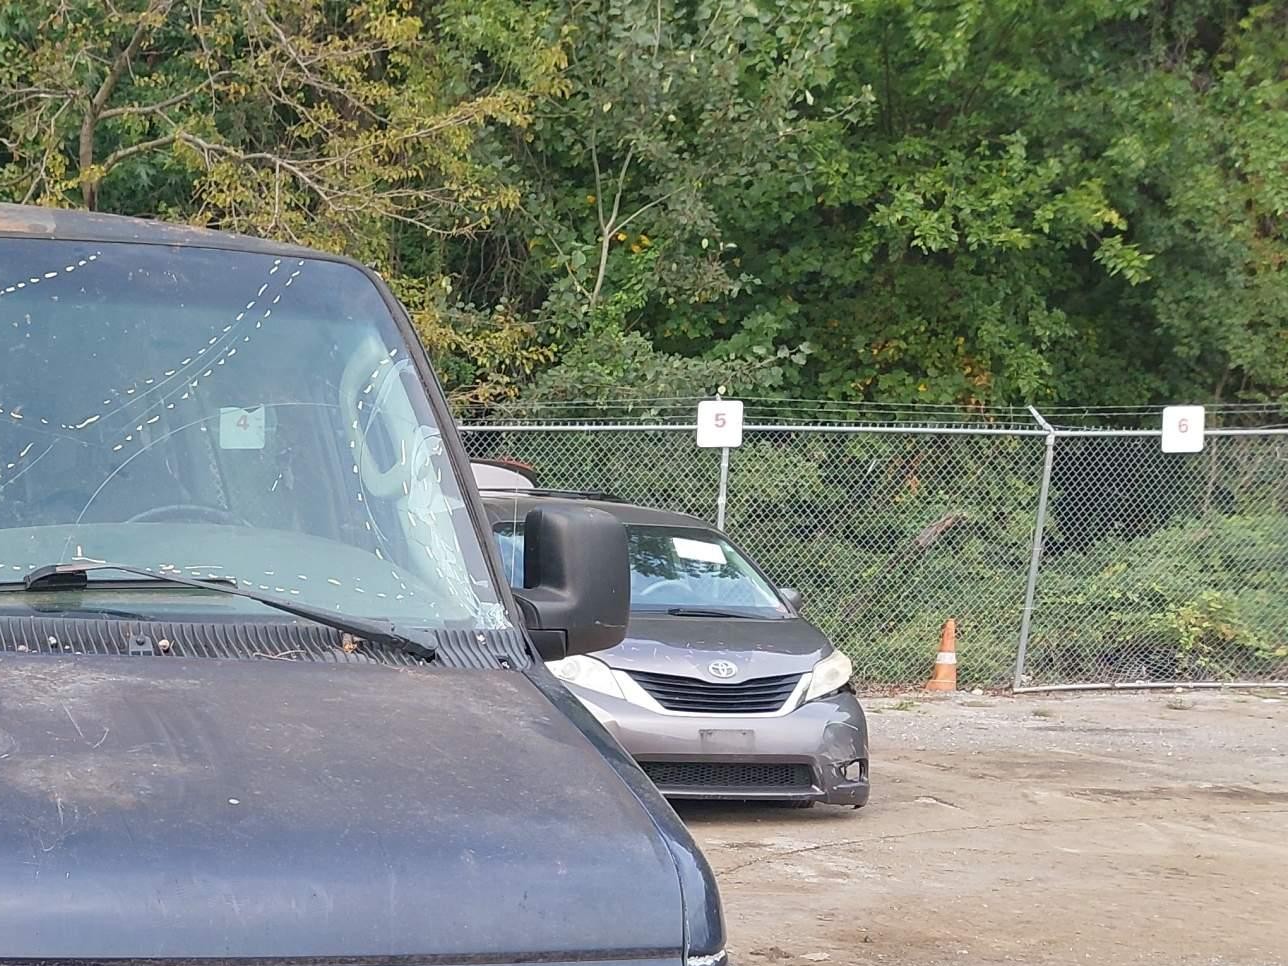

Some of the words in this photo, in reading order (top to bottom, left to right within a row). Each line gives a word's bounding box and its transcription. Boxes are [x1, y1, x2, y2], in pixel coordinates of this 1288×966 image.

[236, 415, 250, 431] 4
[714, 413, 726, 428] 5
[1178, 418, 1189, 433] 6
